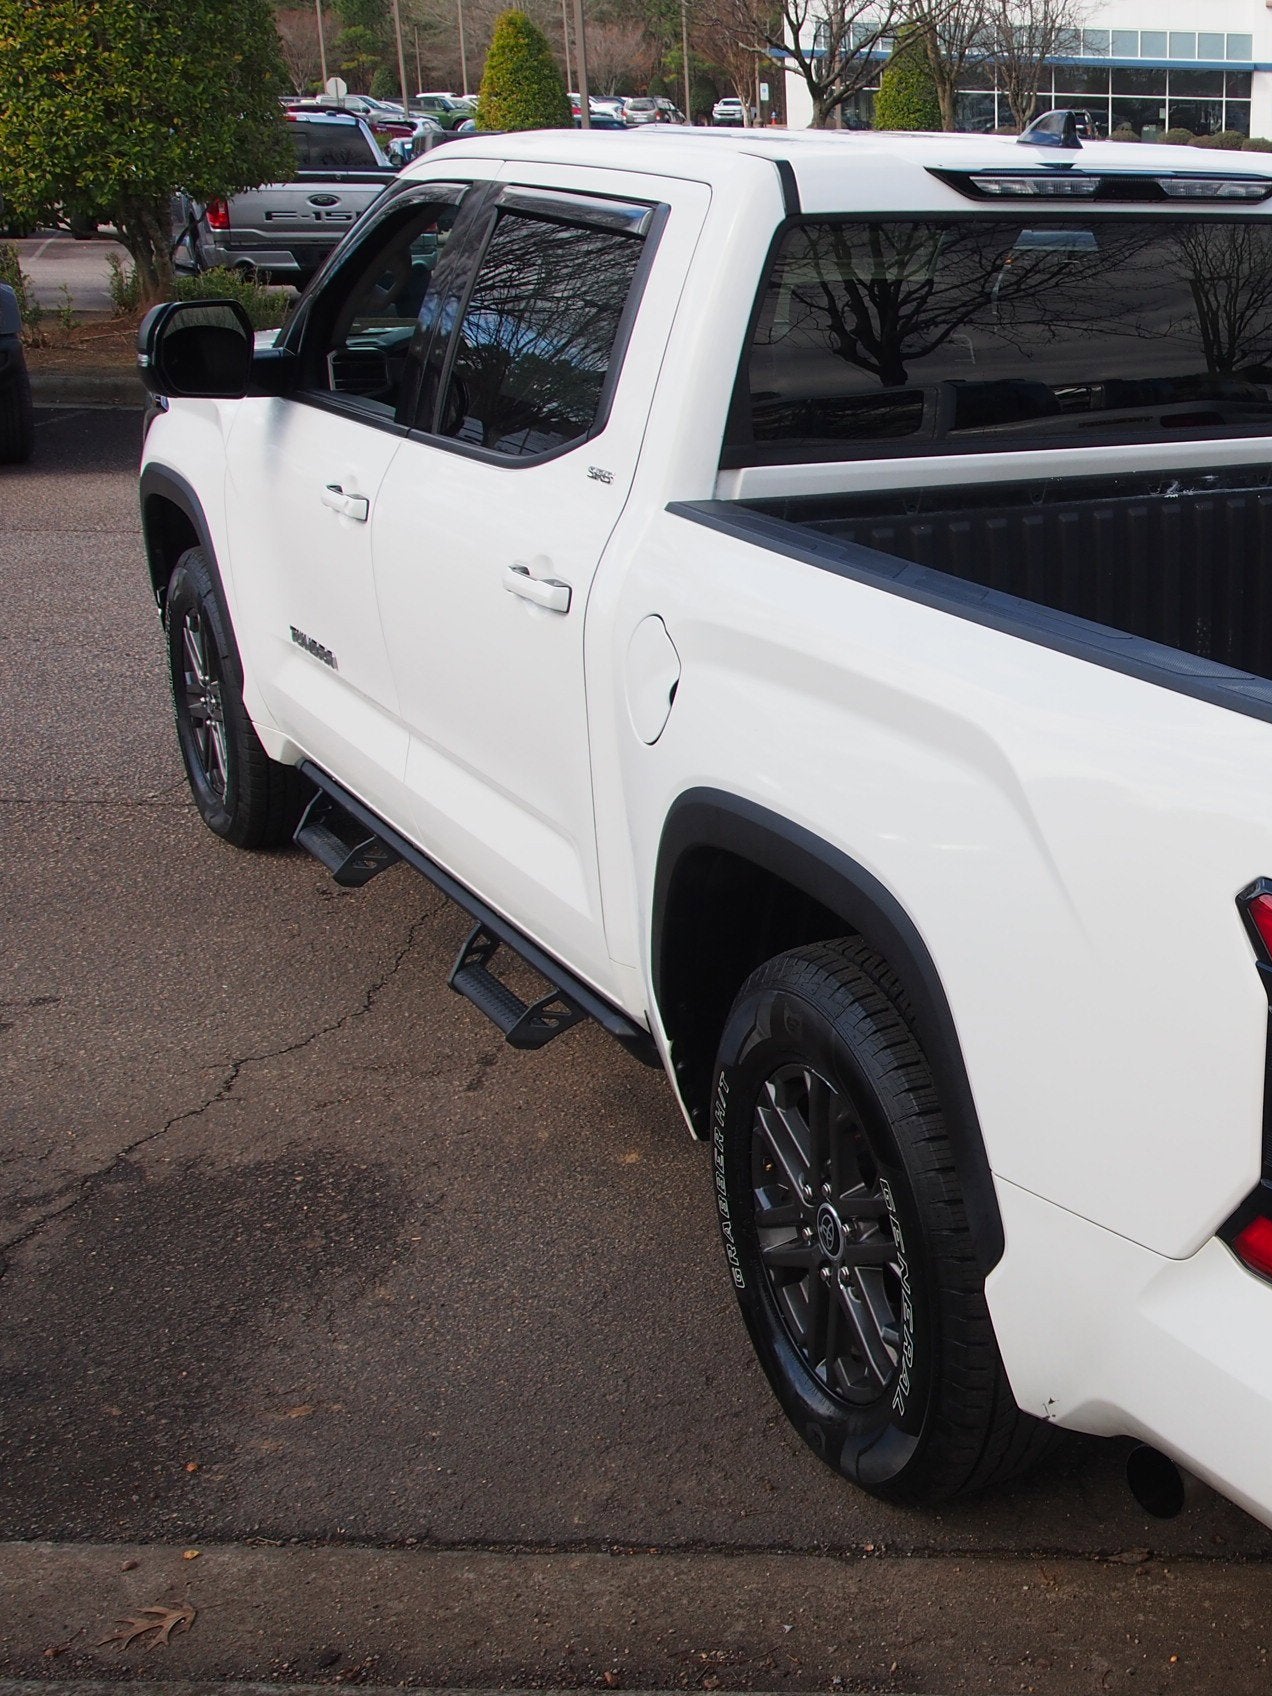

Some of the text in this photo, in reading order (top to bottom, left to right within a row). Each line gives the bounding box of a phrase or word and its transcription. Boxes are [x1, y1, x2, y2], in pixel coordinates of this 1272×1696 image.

[264, 210, 362, 222] F-15
[713, 1126, 746, 1289] GRABBER
[879, 1177, 914, 1417] GENERAL
